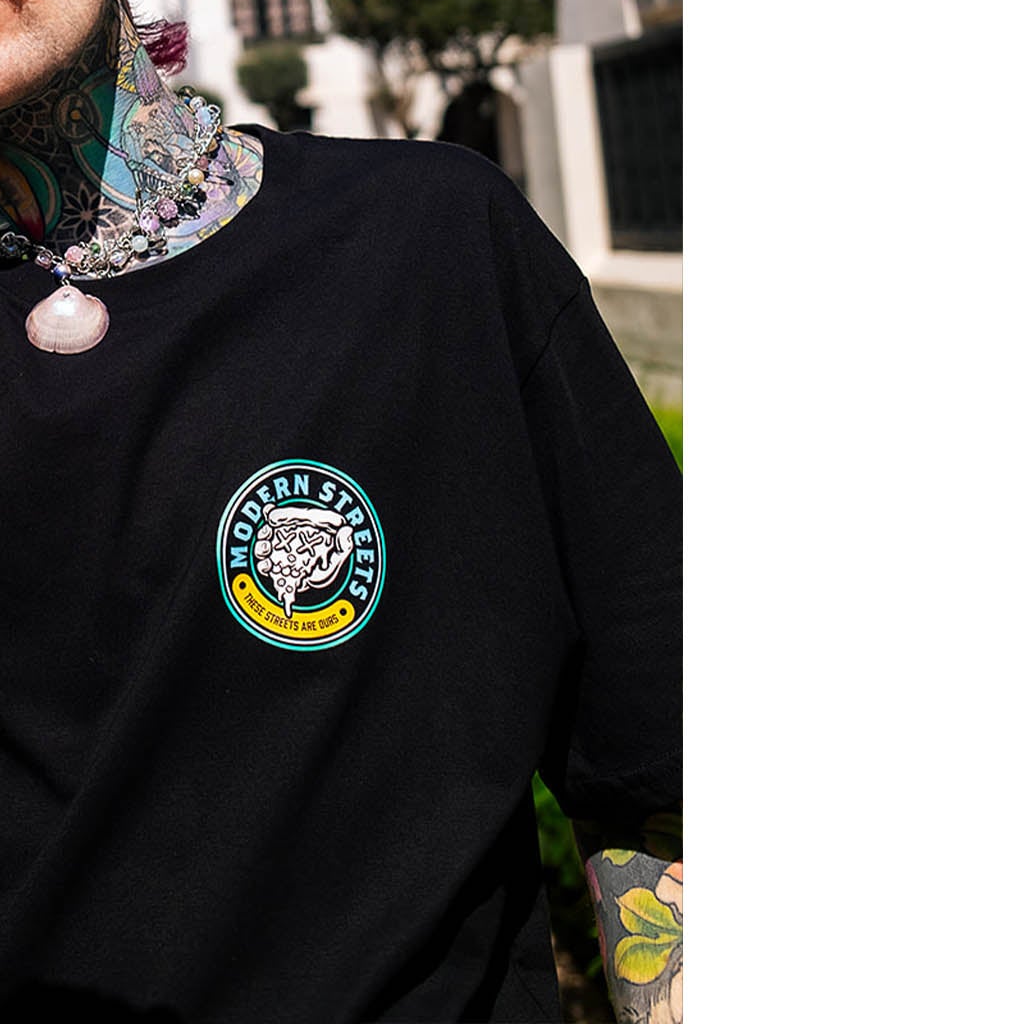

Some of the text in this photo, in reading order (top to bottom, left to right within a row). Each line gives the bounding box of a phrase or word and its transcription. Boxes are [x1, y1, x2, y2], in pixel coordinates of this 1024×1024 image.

[230, 474, 374, 601] MODERN STREETS
[244, 592, 339, 631] THESE STREETS ARE OURS
